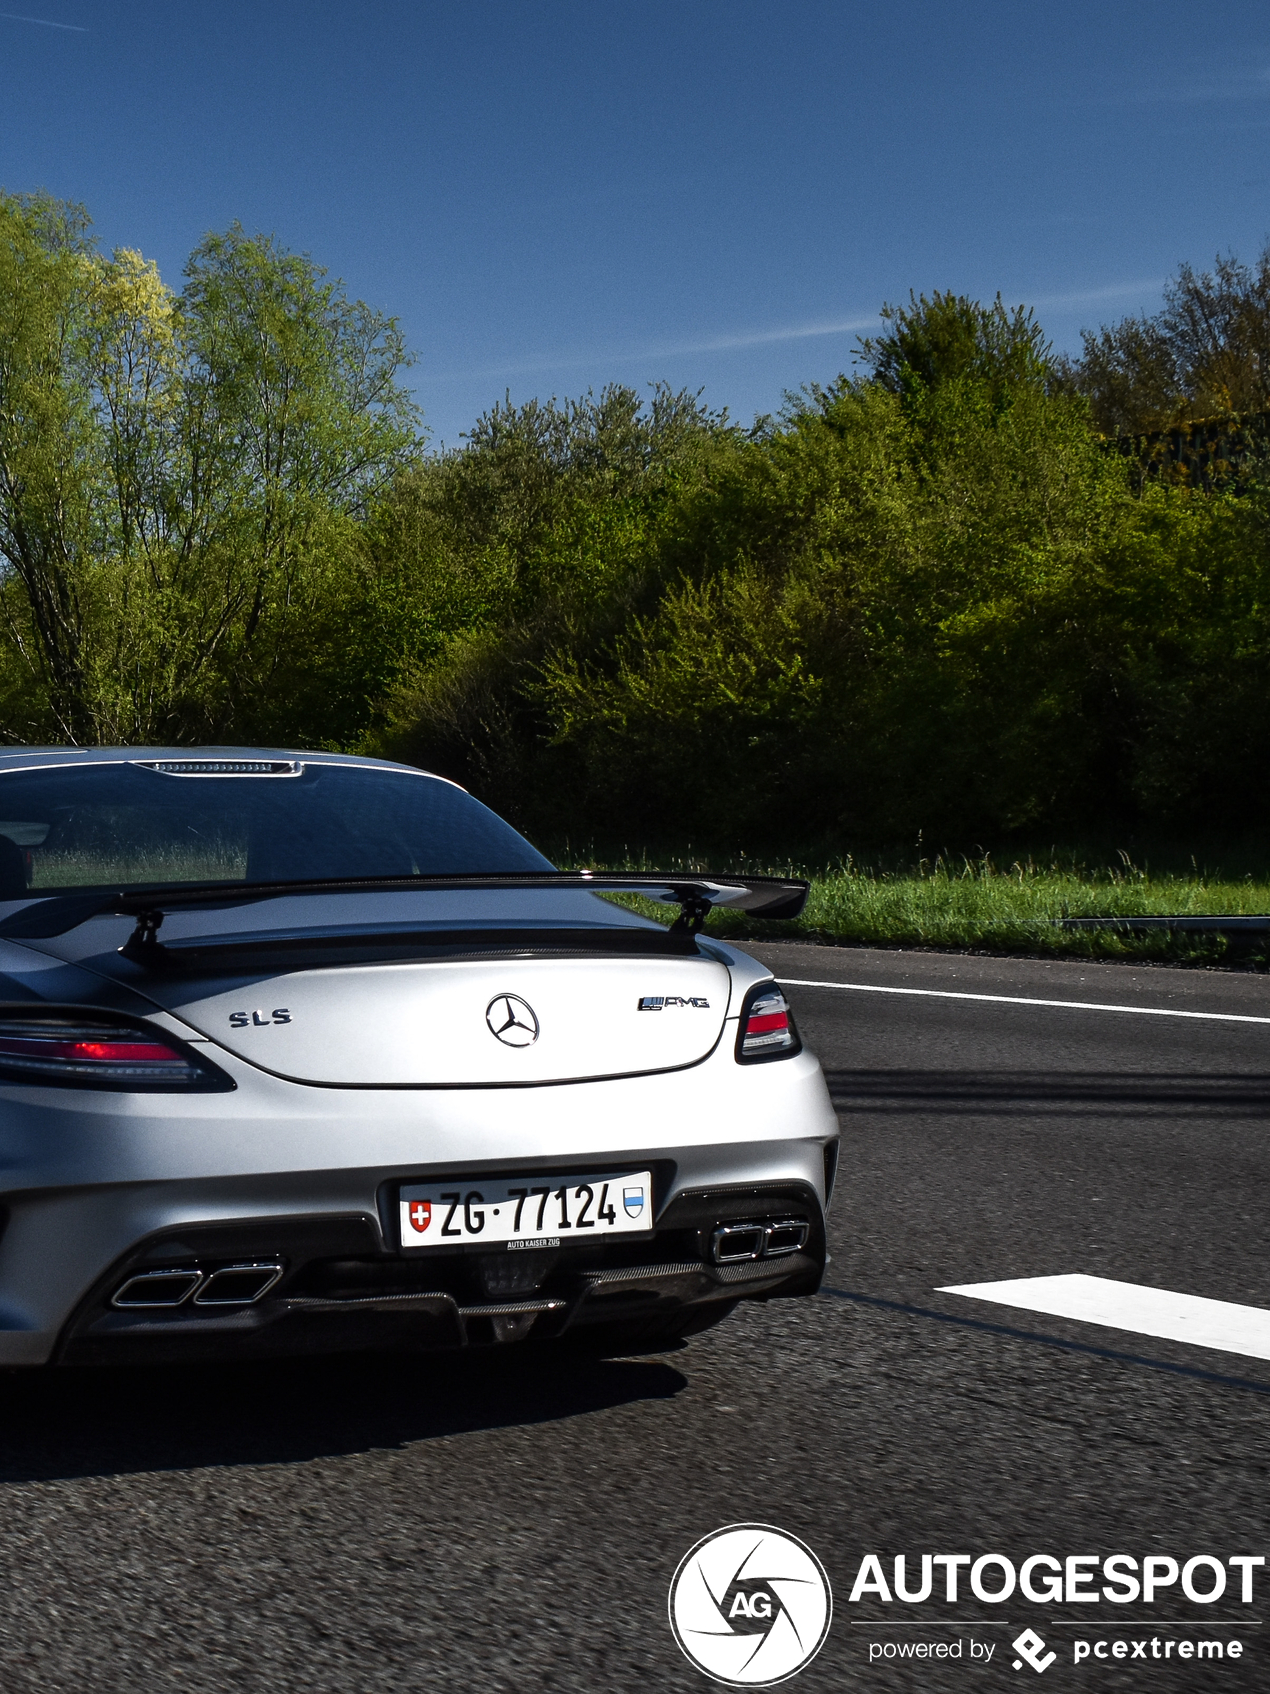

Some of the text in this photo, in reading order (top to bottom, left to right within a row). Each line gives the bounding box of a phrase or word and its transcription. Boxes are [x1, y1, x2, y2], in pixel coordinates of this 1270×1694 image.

[664, 996, 710, 1008] AMG
[229, 1008, 294, 1028] SLS
[507, 1237, 560, 1248] AUTO KAISER ZUG
